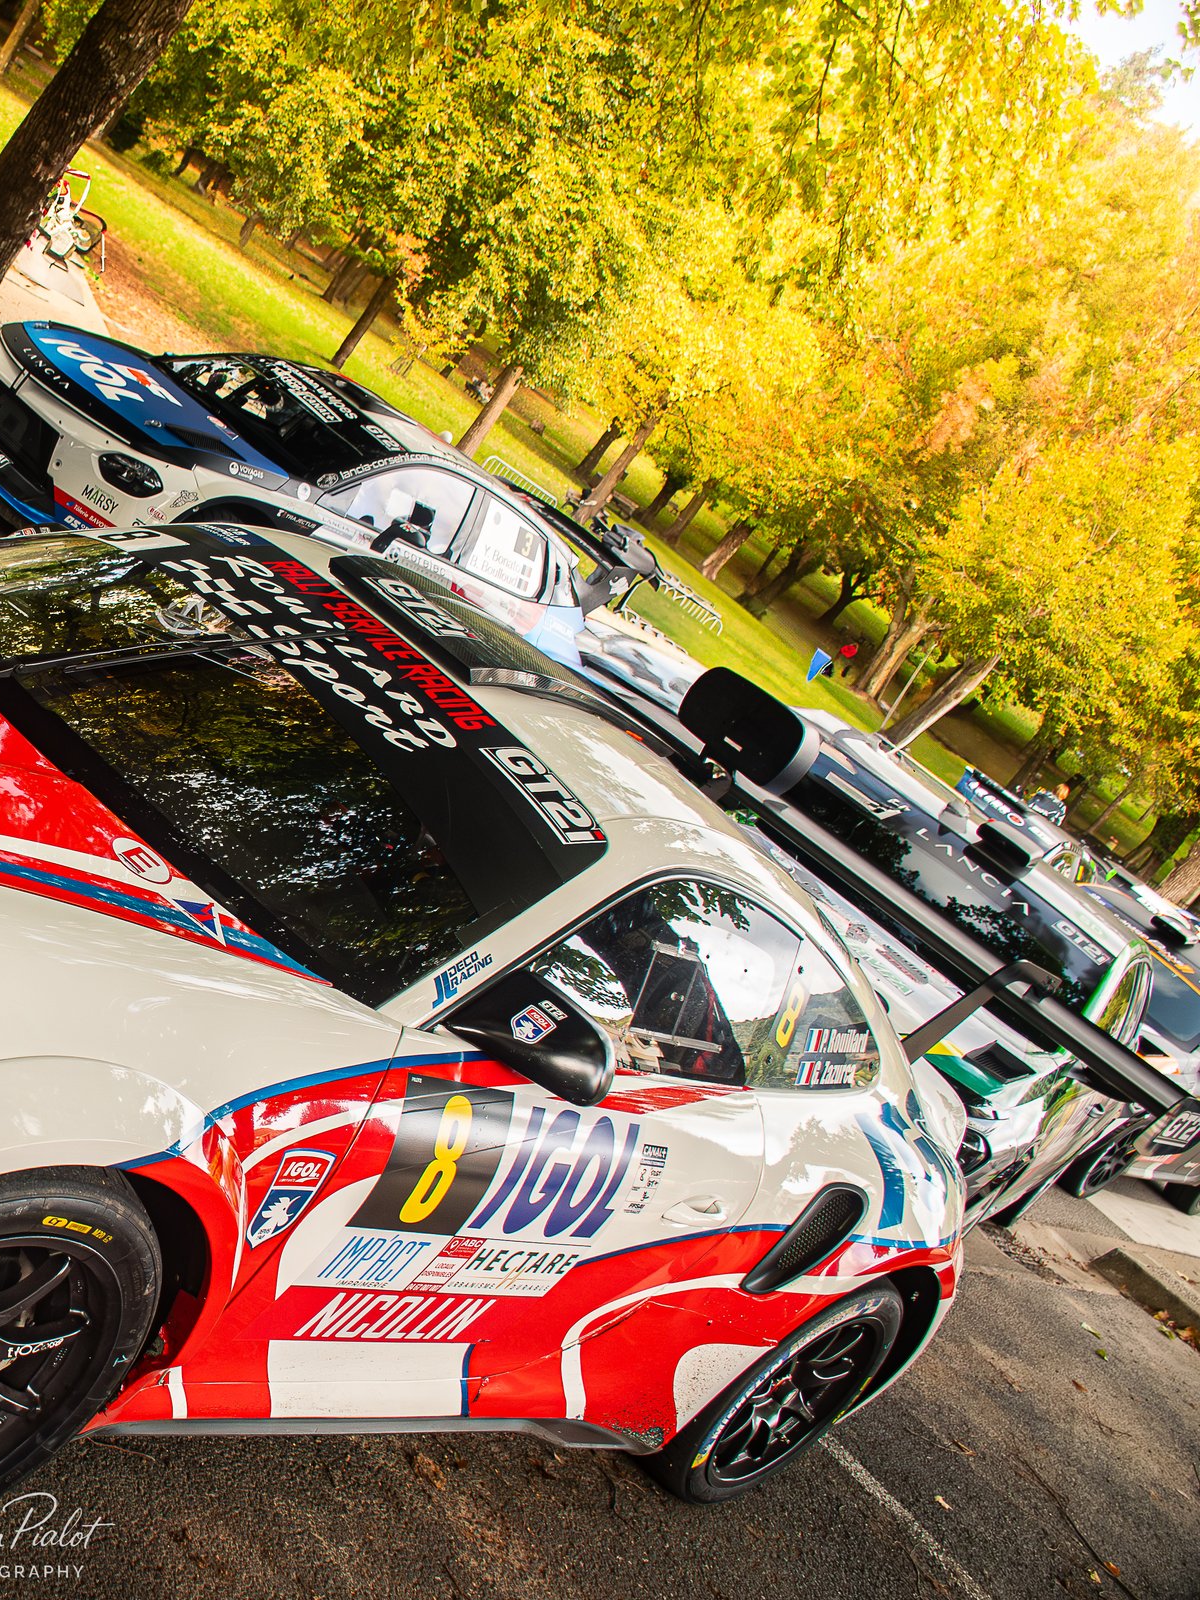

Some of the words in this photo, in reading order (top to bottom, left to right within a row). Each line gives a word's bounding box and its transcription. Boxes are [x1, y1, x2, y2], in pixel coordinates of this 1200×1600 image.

[23, 348, 70, 390] LANCIA
[39, 337, 145, 402] IGOL
[239, 464, 264, 479] VOYAGES
[339, 451, 430, 480] lancia-corsehf.com
[81, 484, 119, 515] MARSY
[97, 530, 161, 542] 8
[522, 532, 534, 556] 3
[403, 550, 446, 577] corelec
[492, 549, 522, 574] Bonato
[262, 559, 347, 598] RALLY
[323, 602, 423, 661] SERVICE
[397, 663, 498, 731] RACING
[480, 746, 606, 845] GT2i
[122, 846, 161, 873] E
[915, 826, 1030, 917] LANCIA
[1051, 919, 1111, 966] GT2i
[448, 951, 479, 975] DECO
[450, 953, 493, 989] RACING
[530, 1010, 550, 1029] IGOL
[775, 981, 806, 1048] 8
[819, 1029, 830, 1053] P.
[827, 1029, 870, 1053] Rouillard
[399, 1095, 473, 1224] 8
[467, 1105, 641, 1239] IGOL
[460, 1238, 484, 1248] ABC
[465, 1247, 580, 1275] HECTARE
[335, 1280, 388, 1289] IMPRIMERIE
[447, 1280, 496, 1290] URBANISME
[509, 1283, 551, 1292] DURABLE
[292, 1291, 498, 1340] NICOLLIN
